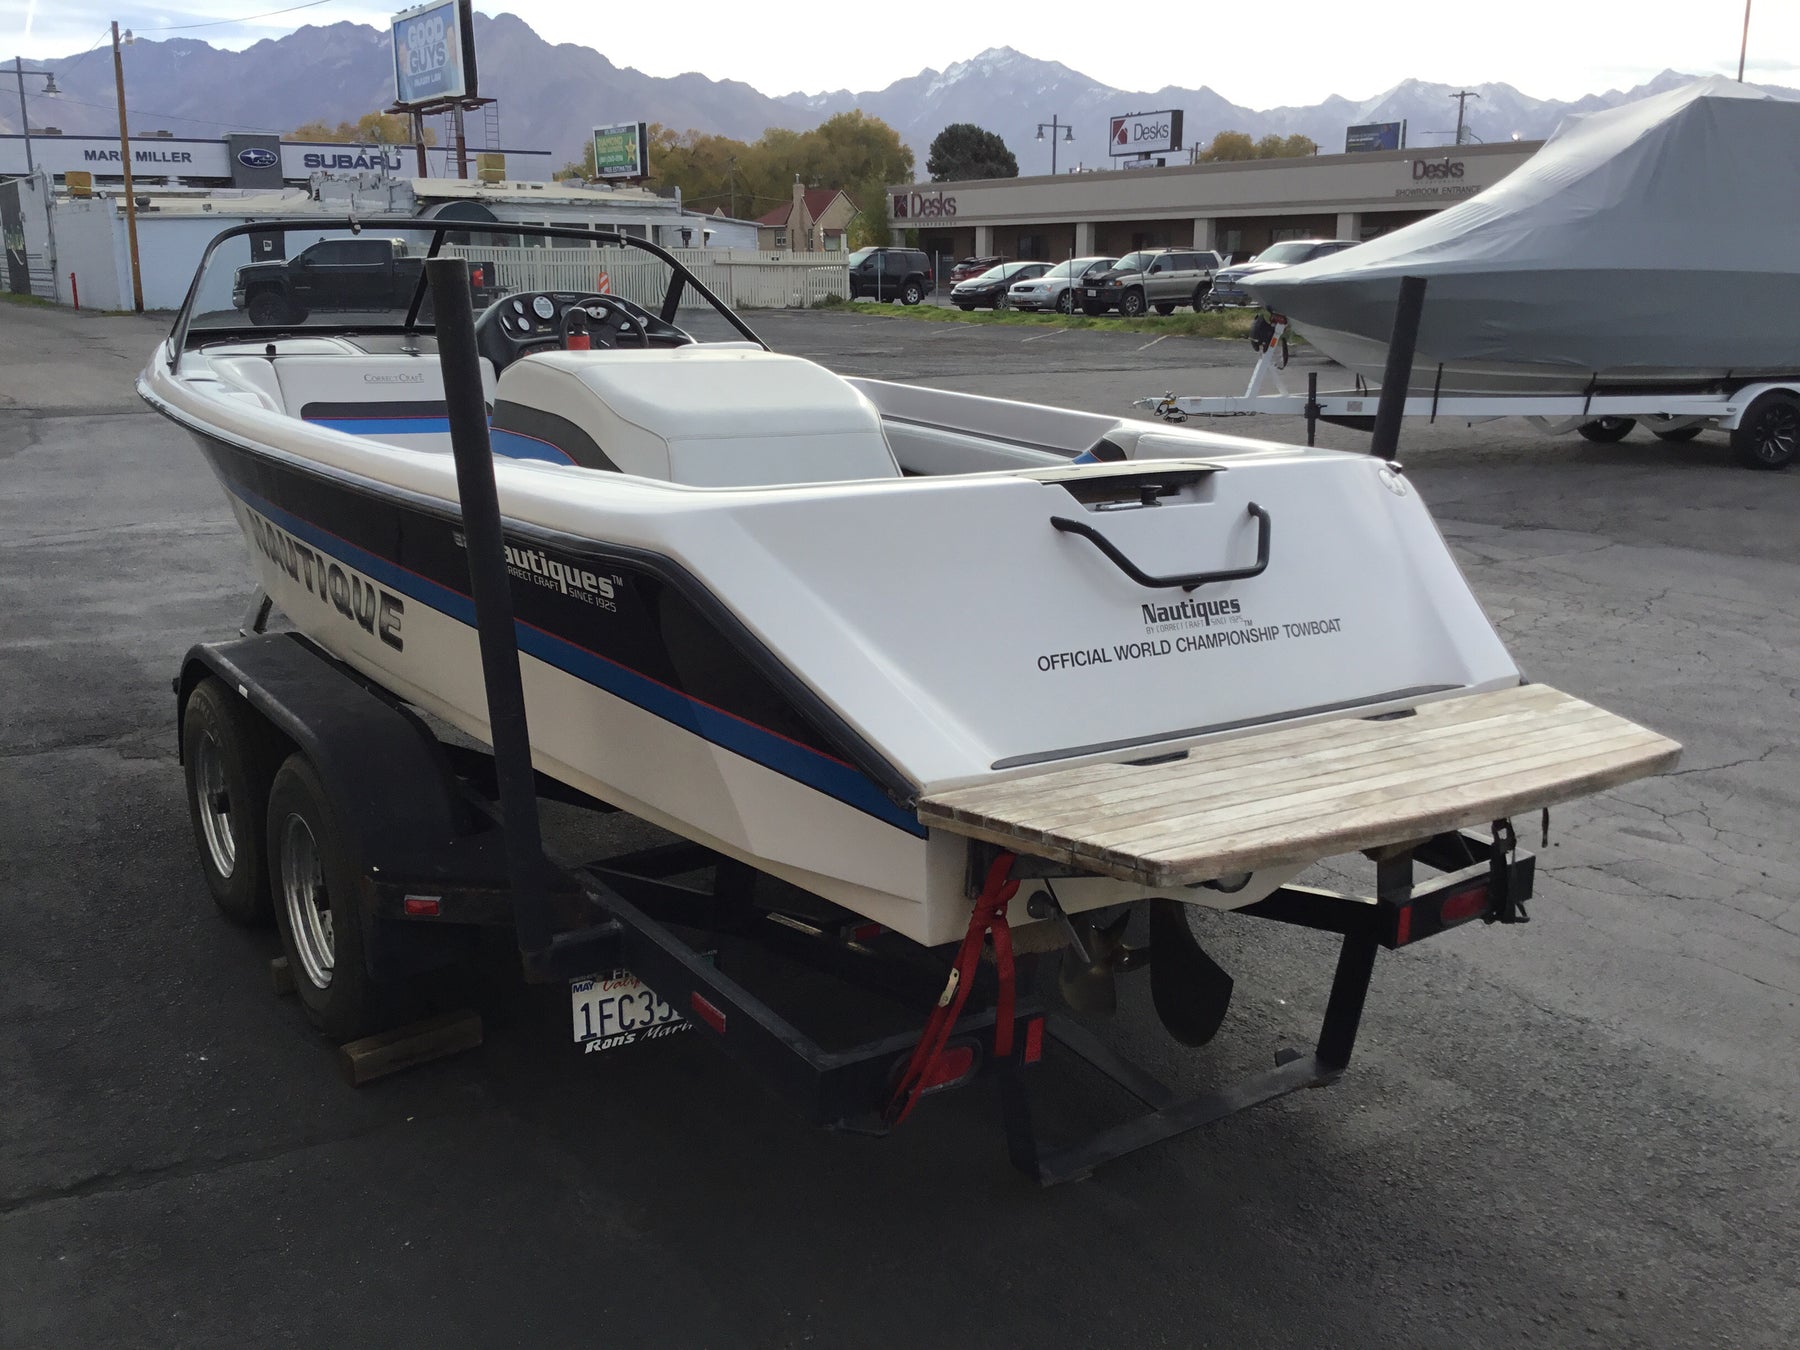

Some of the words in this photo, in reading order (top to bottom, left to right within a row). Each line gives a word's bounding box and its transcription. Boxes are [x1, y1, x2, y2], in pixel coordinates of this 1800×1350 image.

[408, 16, 444, 49] GOOD
[409, 41, 446, 74] GUYS
[1133, 121, 1169, 141] Desks
[136, 151, 192, 163] MILLER
[303, 153, 402, 171] SUBARU
[1413, 159, 1464, 180] Desks
[911, 192, 957, 217] Desks
[1395, 187, 1438, 198] SHOWROOM
[1442, 184, 1481, 194] ENTRANCE
[246, 507, 404, 653] NAUTIQUE
[503, 545, 614, 599] autiques
[508, 567, 532, 582] RRECT
[533, 575, 560, 592] CRAFT
[569, 587, 594, 605] SINCE
[595, 596, 617, 613] 1925
[1141, 599, 1241, 626] Nautiques
[1146, 626, 1155, 635] BY
[1156, 622, 1184, 634] CORRECT
[1037, 647, 1112, 672] OFFICIAL
[1113, 639, 1172, 661] WORLD
[1175, 626, 1280, 653] CHAMPIONSHIP
[1282, 618, 1342, 639] TOWBOAT
[572, 980, 594, 993] MAY
[579, 991, 674, 1041] 1FC35
[585, 1031, 636, 1054] Ron's
[640, 1020, 694, 1041] Mari
